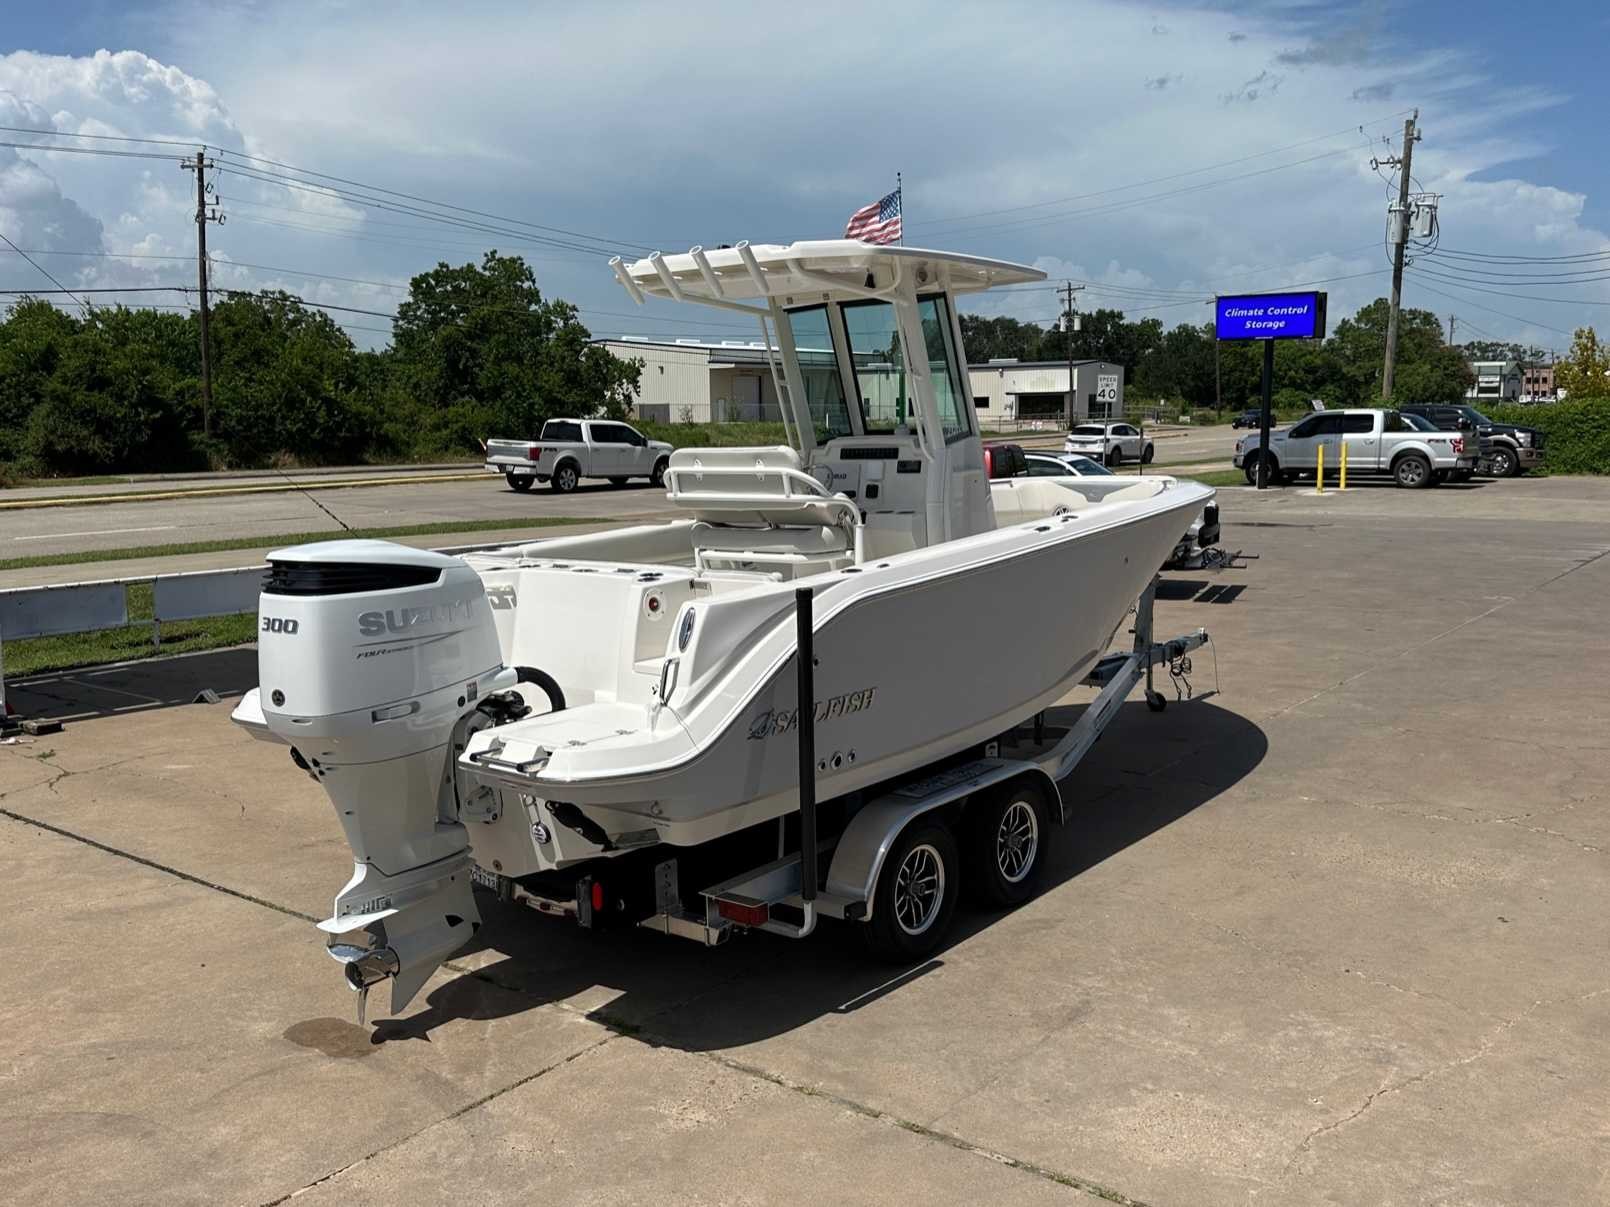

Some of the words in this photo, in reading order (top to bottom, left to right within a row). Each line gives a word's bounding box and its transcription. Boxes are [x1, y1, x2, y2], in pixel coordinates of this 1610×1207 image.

[1224, 307, 1264, 317] Climate
[1267, 305, 1308, 315] Control
[1244, 320, 1286, 330] Storage
[1098, 388, 1116, 400] 40
[261, 617, 299, 635] 300
[774, 687, 878, 735] SALFISH
